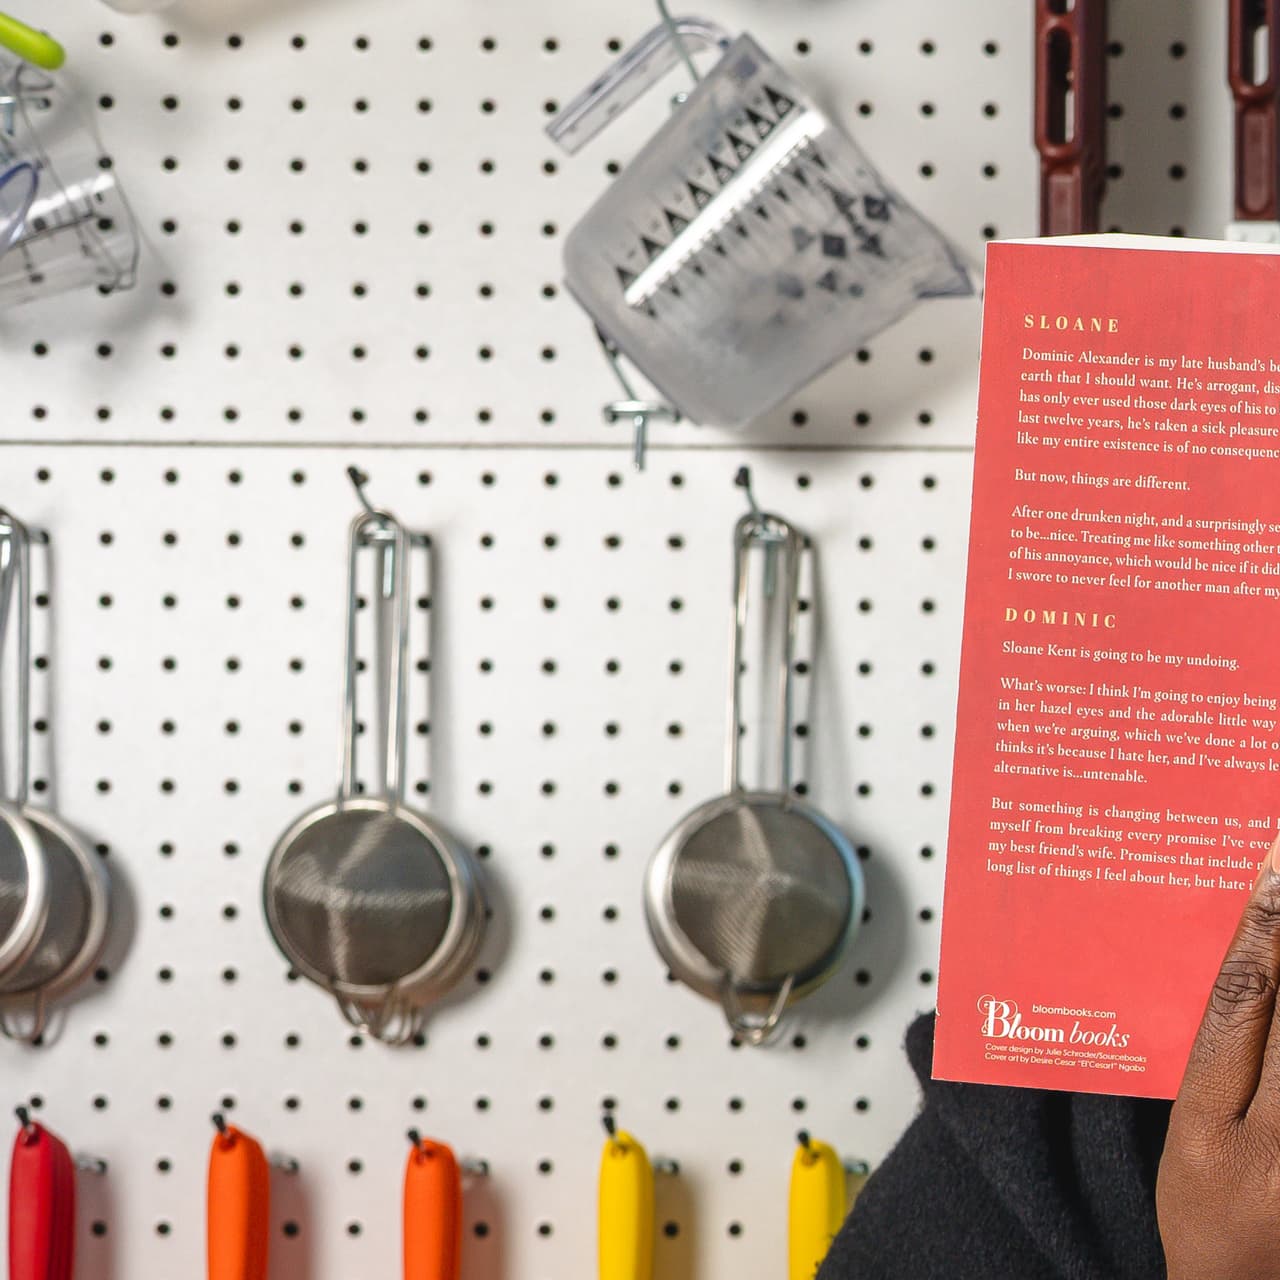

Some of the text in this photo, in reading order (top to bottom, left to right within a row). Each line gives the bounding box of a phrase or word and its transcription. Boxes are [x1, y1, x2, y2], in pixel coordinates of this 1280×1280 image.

[1024, 314, 1119, 333] SLOANE
[1022, 347, 1074, 362] Dominic
[1078, 350, 1140, 366] Alexander
[1144, 352, 1154, 366] is
[1159, 357, 1177, 371] my
[1181, 355, 1203, 369] late
[1207, 357, 1266, 372] husband's
[1004, 607, 1117, 629] DOMINIC
[1002, 641, 1240, 671] Sloane Kent is going to be my undoing.
[977, 994, 1130, 1047] Bloom books
[1032, 1004, 1116, 1019] bloombooks.com
[985, 1043, 1007, 1051] Cover
[1009, 1045, 1033, 1055] design
[1034, 1046, 1044, 1055] by
[985, 1053, 1006, 1061] Cover
[1020, 1055, 1030, 1063] by
